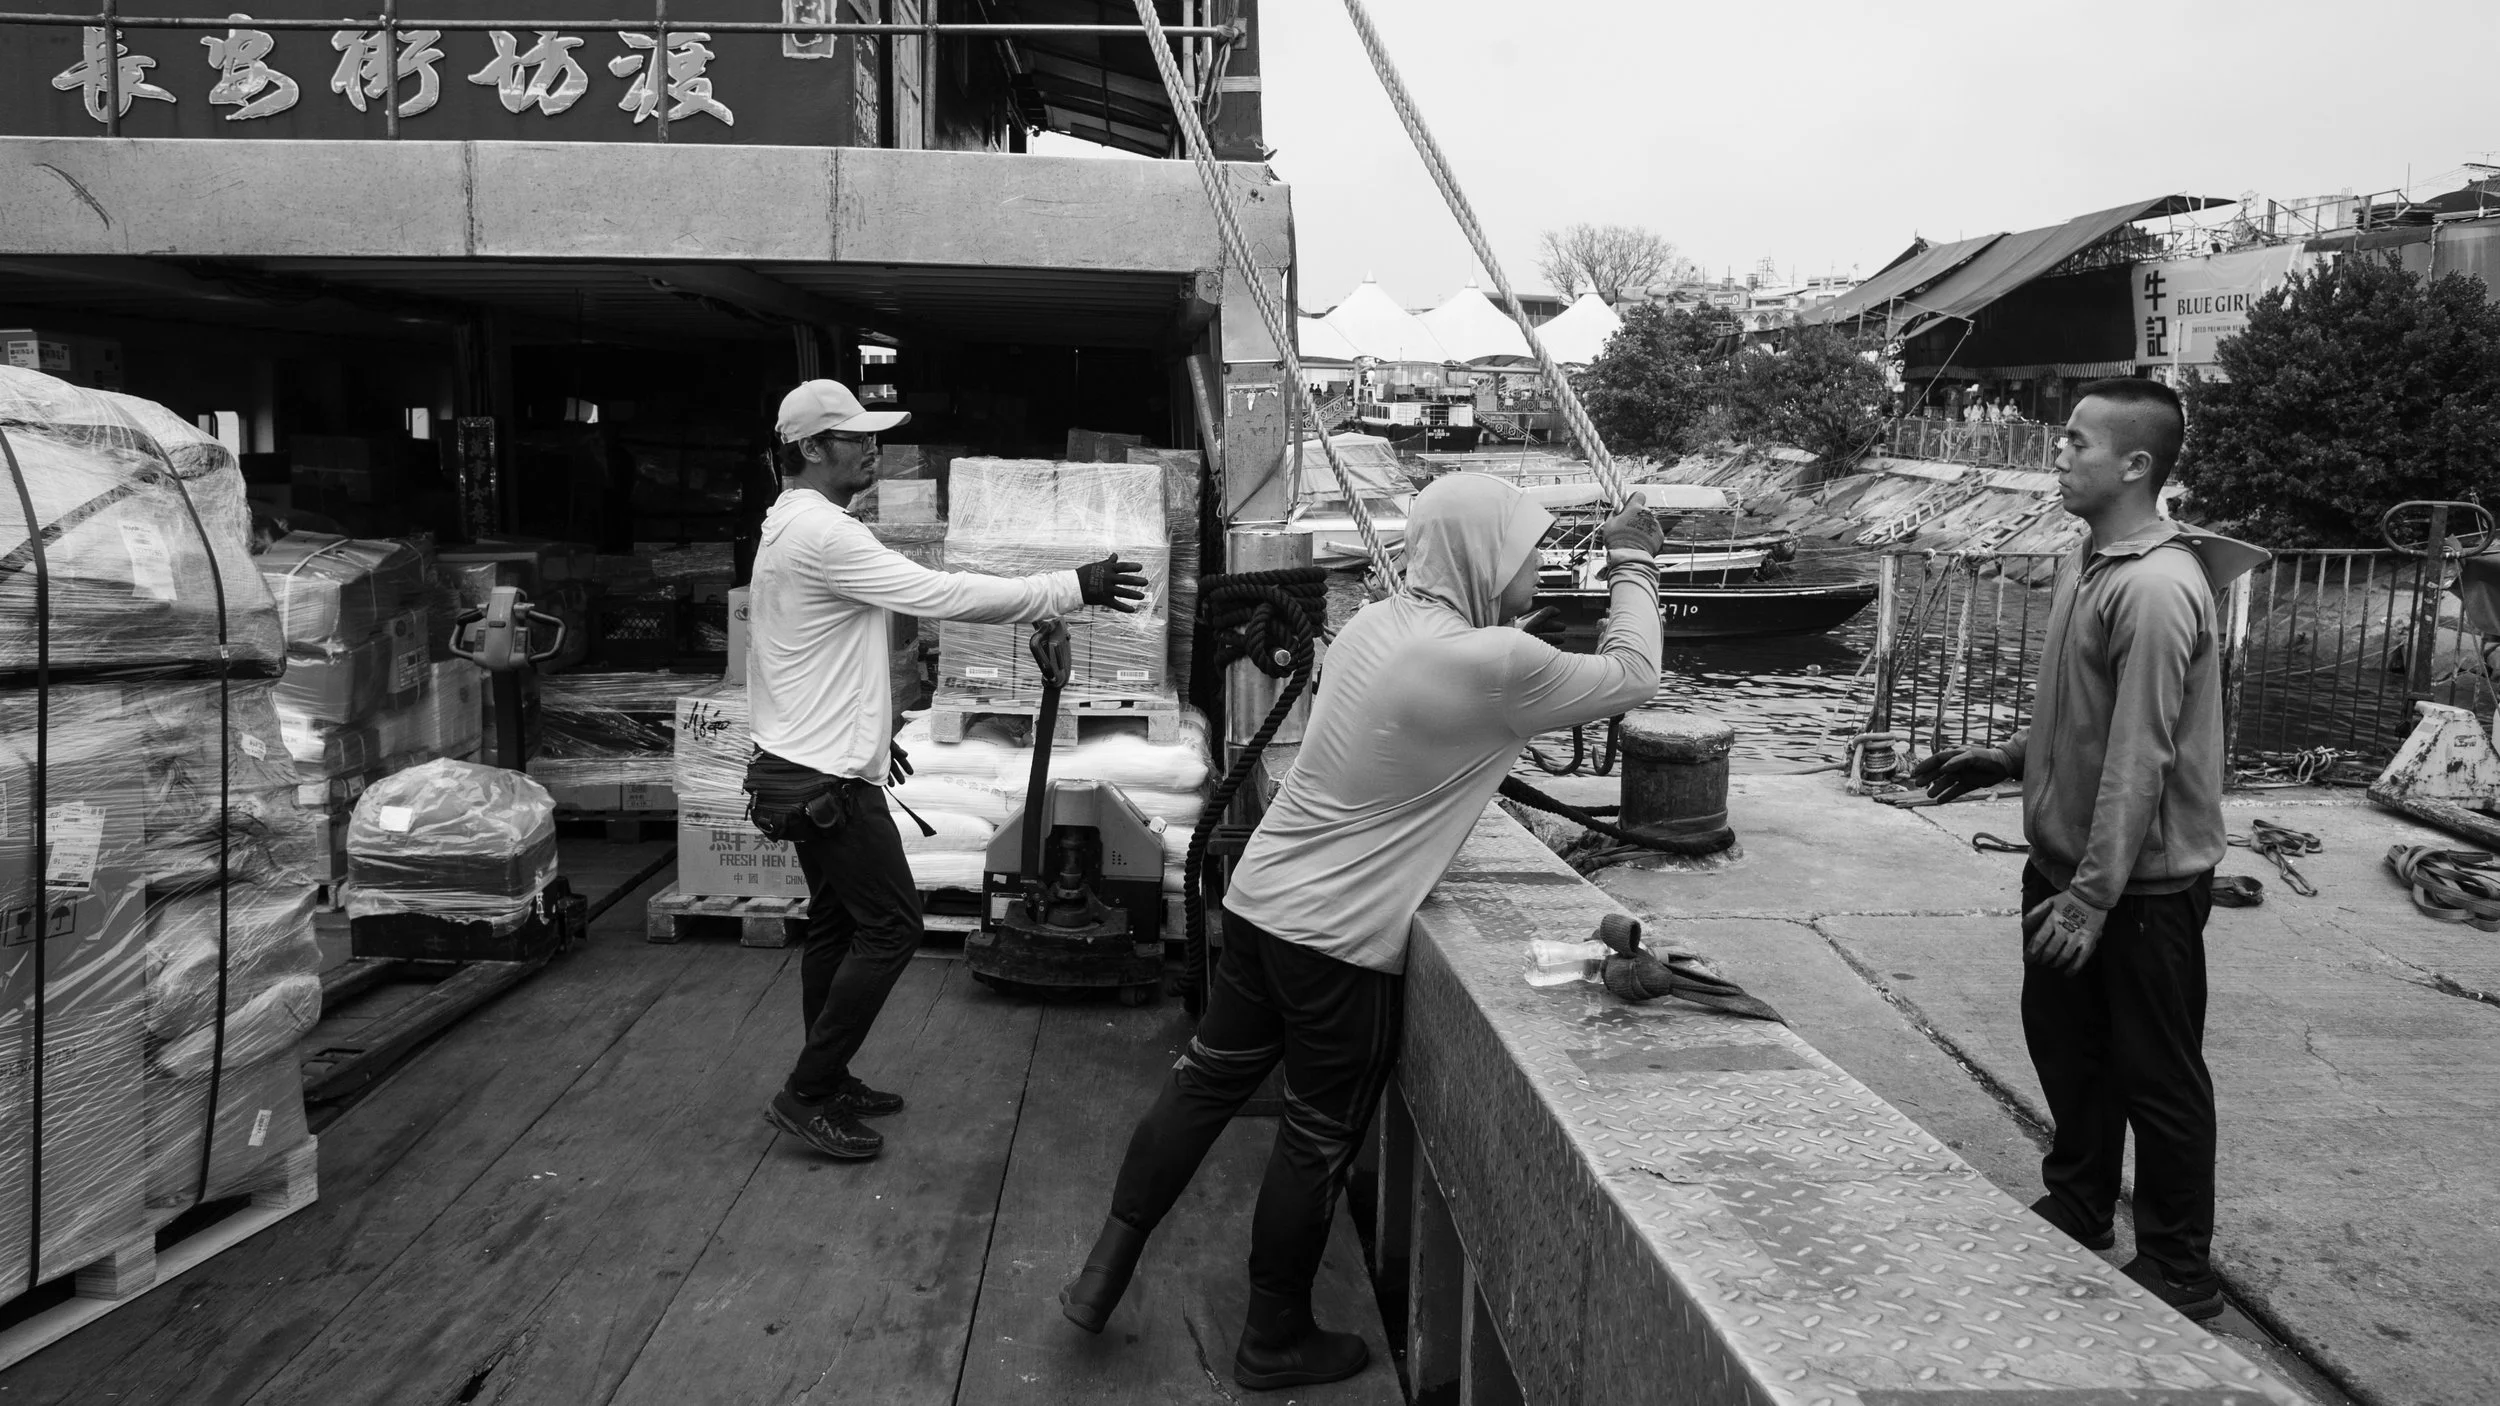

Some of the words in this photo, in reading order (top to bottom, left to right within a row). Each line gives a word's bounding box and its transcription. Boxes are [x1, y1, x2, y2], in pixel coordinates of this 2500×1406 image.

[2144, 270, 2168, 357] 牛記
[2177, 297, 2212, 316] BLUE
[720, 854, 757, 866] FRESH
[762, 855, 786, 868] HEN
[791, 856, 802, 868] E
